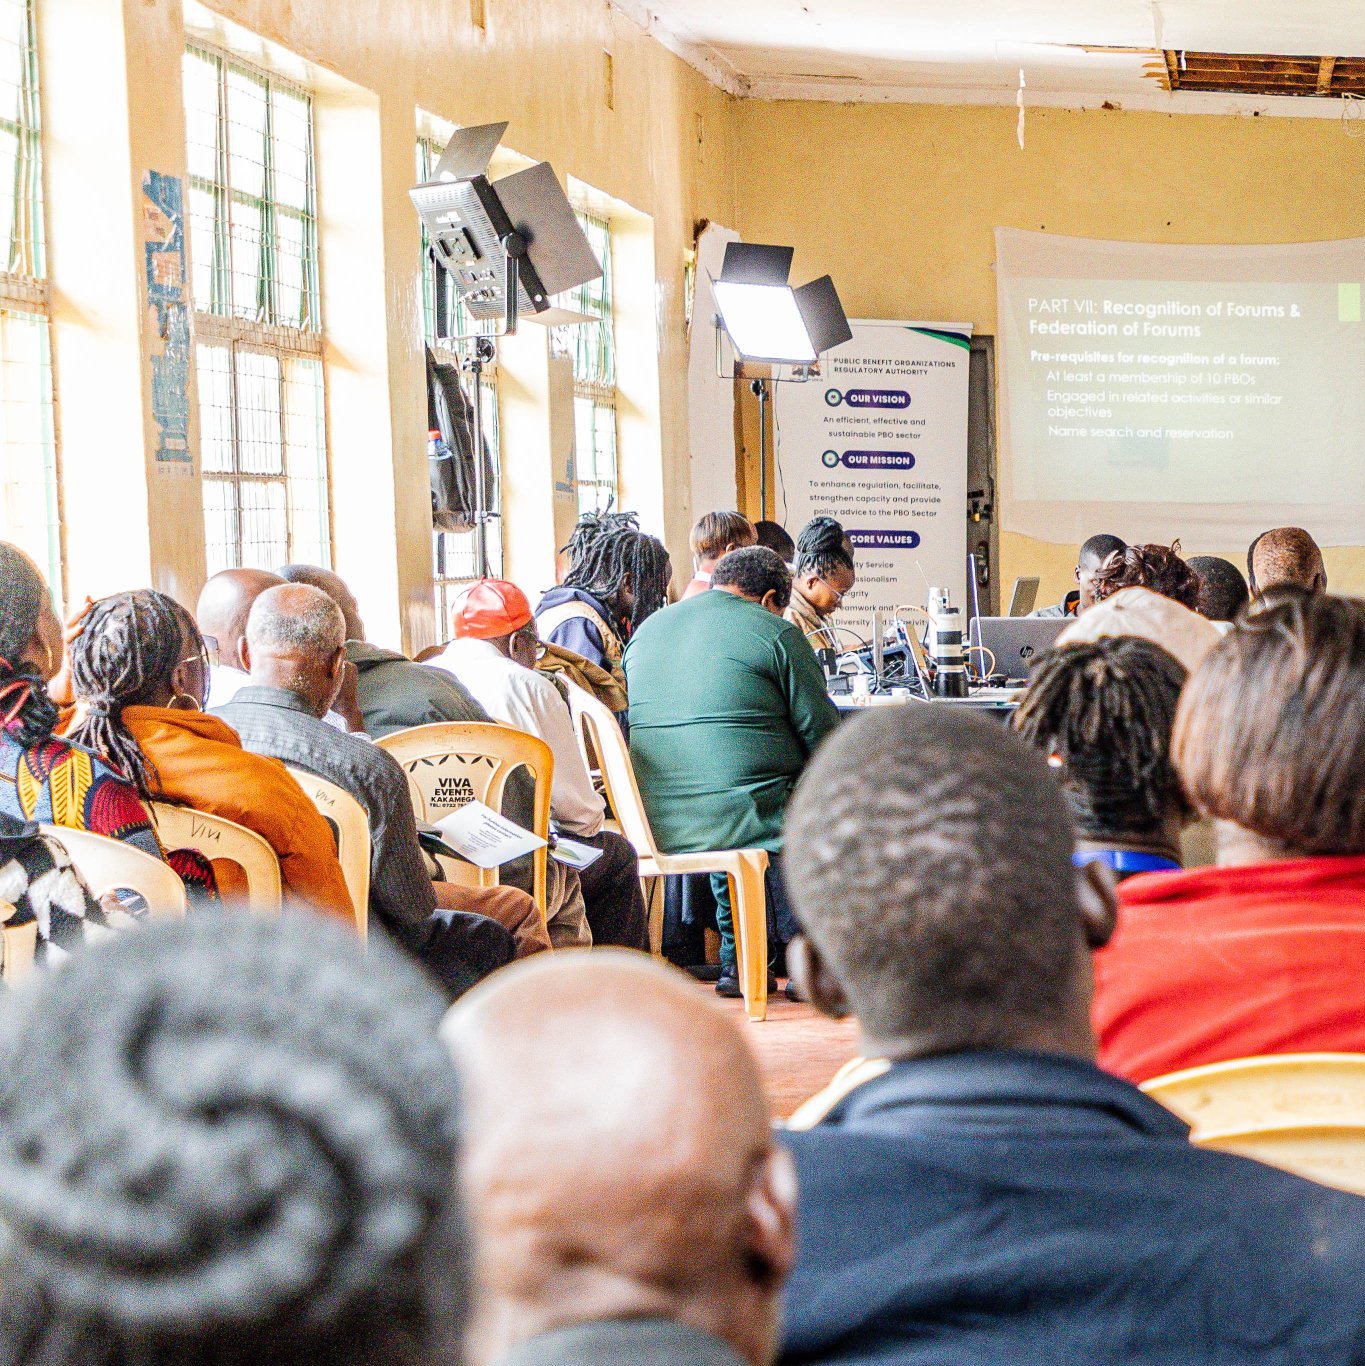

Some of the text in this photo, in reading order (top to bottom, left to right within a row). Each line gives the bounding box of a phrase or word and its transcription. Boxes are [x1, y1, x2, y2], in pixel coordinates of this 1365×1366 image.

[1028, 298, 1301, 318] PART VII: Recognition of Forums &
[1029, 319, 1201, 336] Federation of Forums
[1030, 350, 1280, 366] Pre-requisites for recognition of a forum:
[1046, 370, 1256, 386] At least a membership of 10 PBOs
[851, 395, 906, 404] OUR VISION
[1047, 390, 1283, 404] Engaged in related activities or similar
[1047, 406, 1113, 419] objectives
[828, 430, 876, 438] sustainable
[1048, 426, 1234, 439] Name search and reservation
[848, 456, 910, 464] OUR MISSION
[810, 495, 854, 503] strengthen
[856, 496, 890, 504] capacity
[814, 508, 838, 516] policy
[850, 536, 912, 544] CORE VALUES
[438, 778, 471, 788] VIVA
[315, 789, 336, 806] VIVA
[435, 788, 474, 796] EVENTS
[190, 815, 221, 843] VIVA
